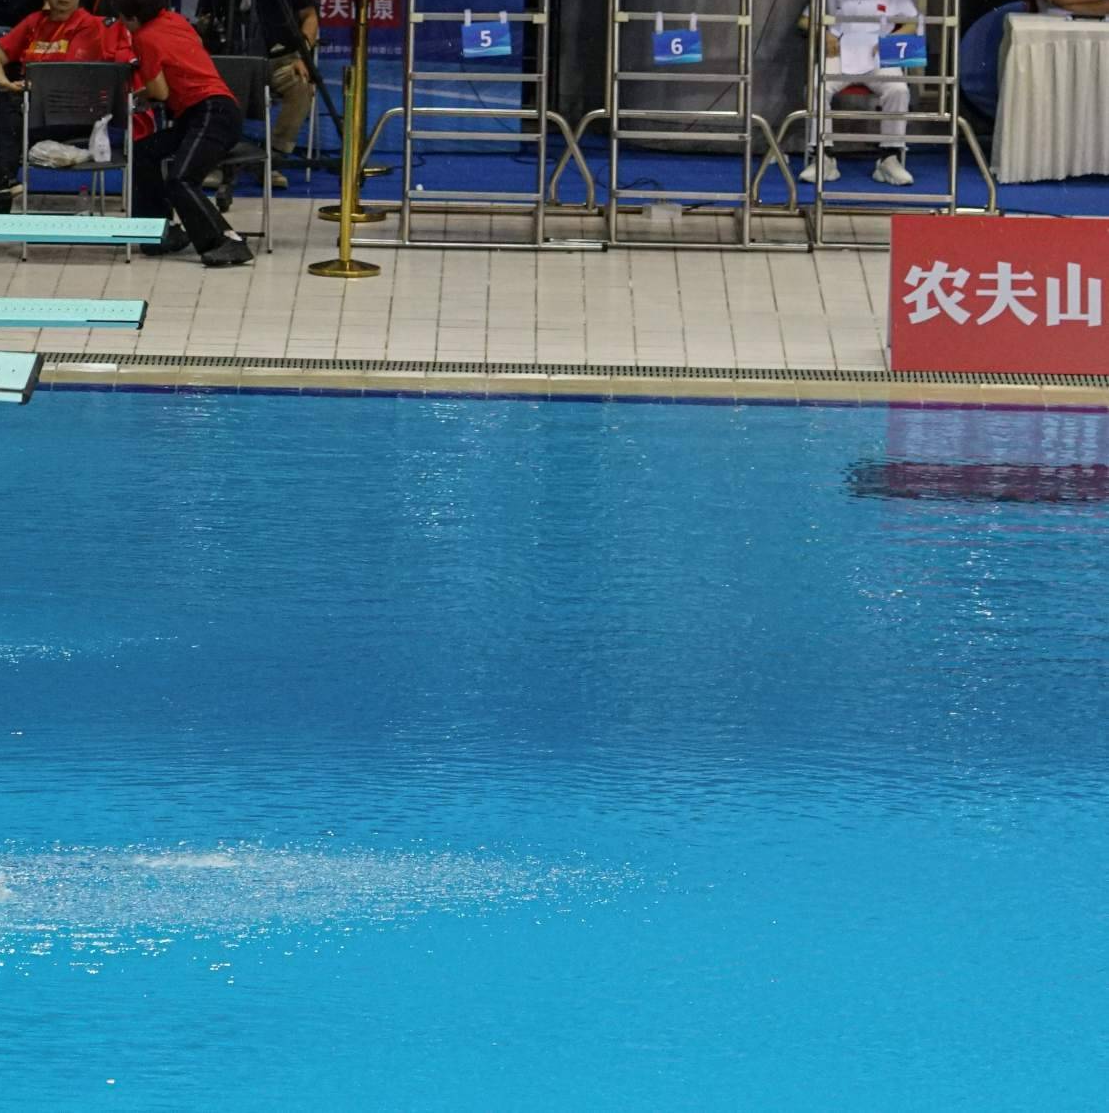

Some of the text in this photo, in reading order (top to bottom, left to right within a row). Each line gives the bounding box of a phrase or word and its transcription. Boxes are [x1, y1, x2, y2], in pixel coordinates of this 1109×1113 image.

[480, 30, 492, 47] 5
[670, 37, 683, 55] 6
[895, 42, 908, 58] 7
[902, 260, 1102, 326] 农夫山
